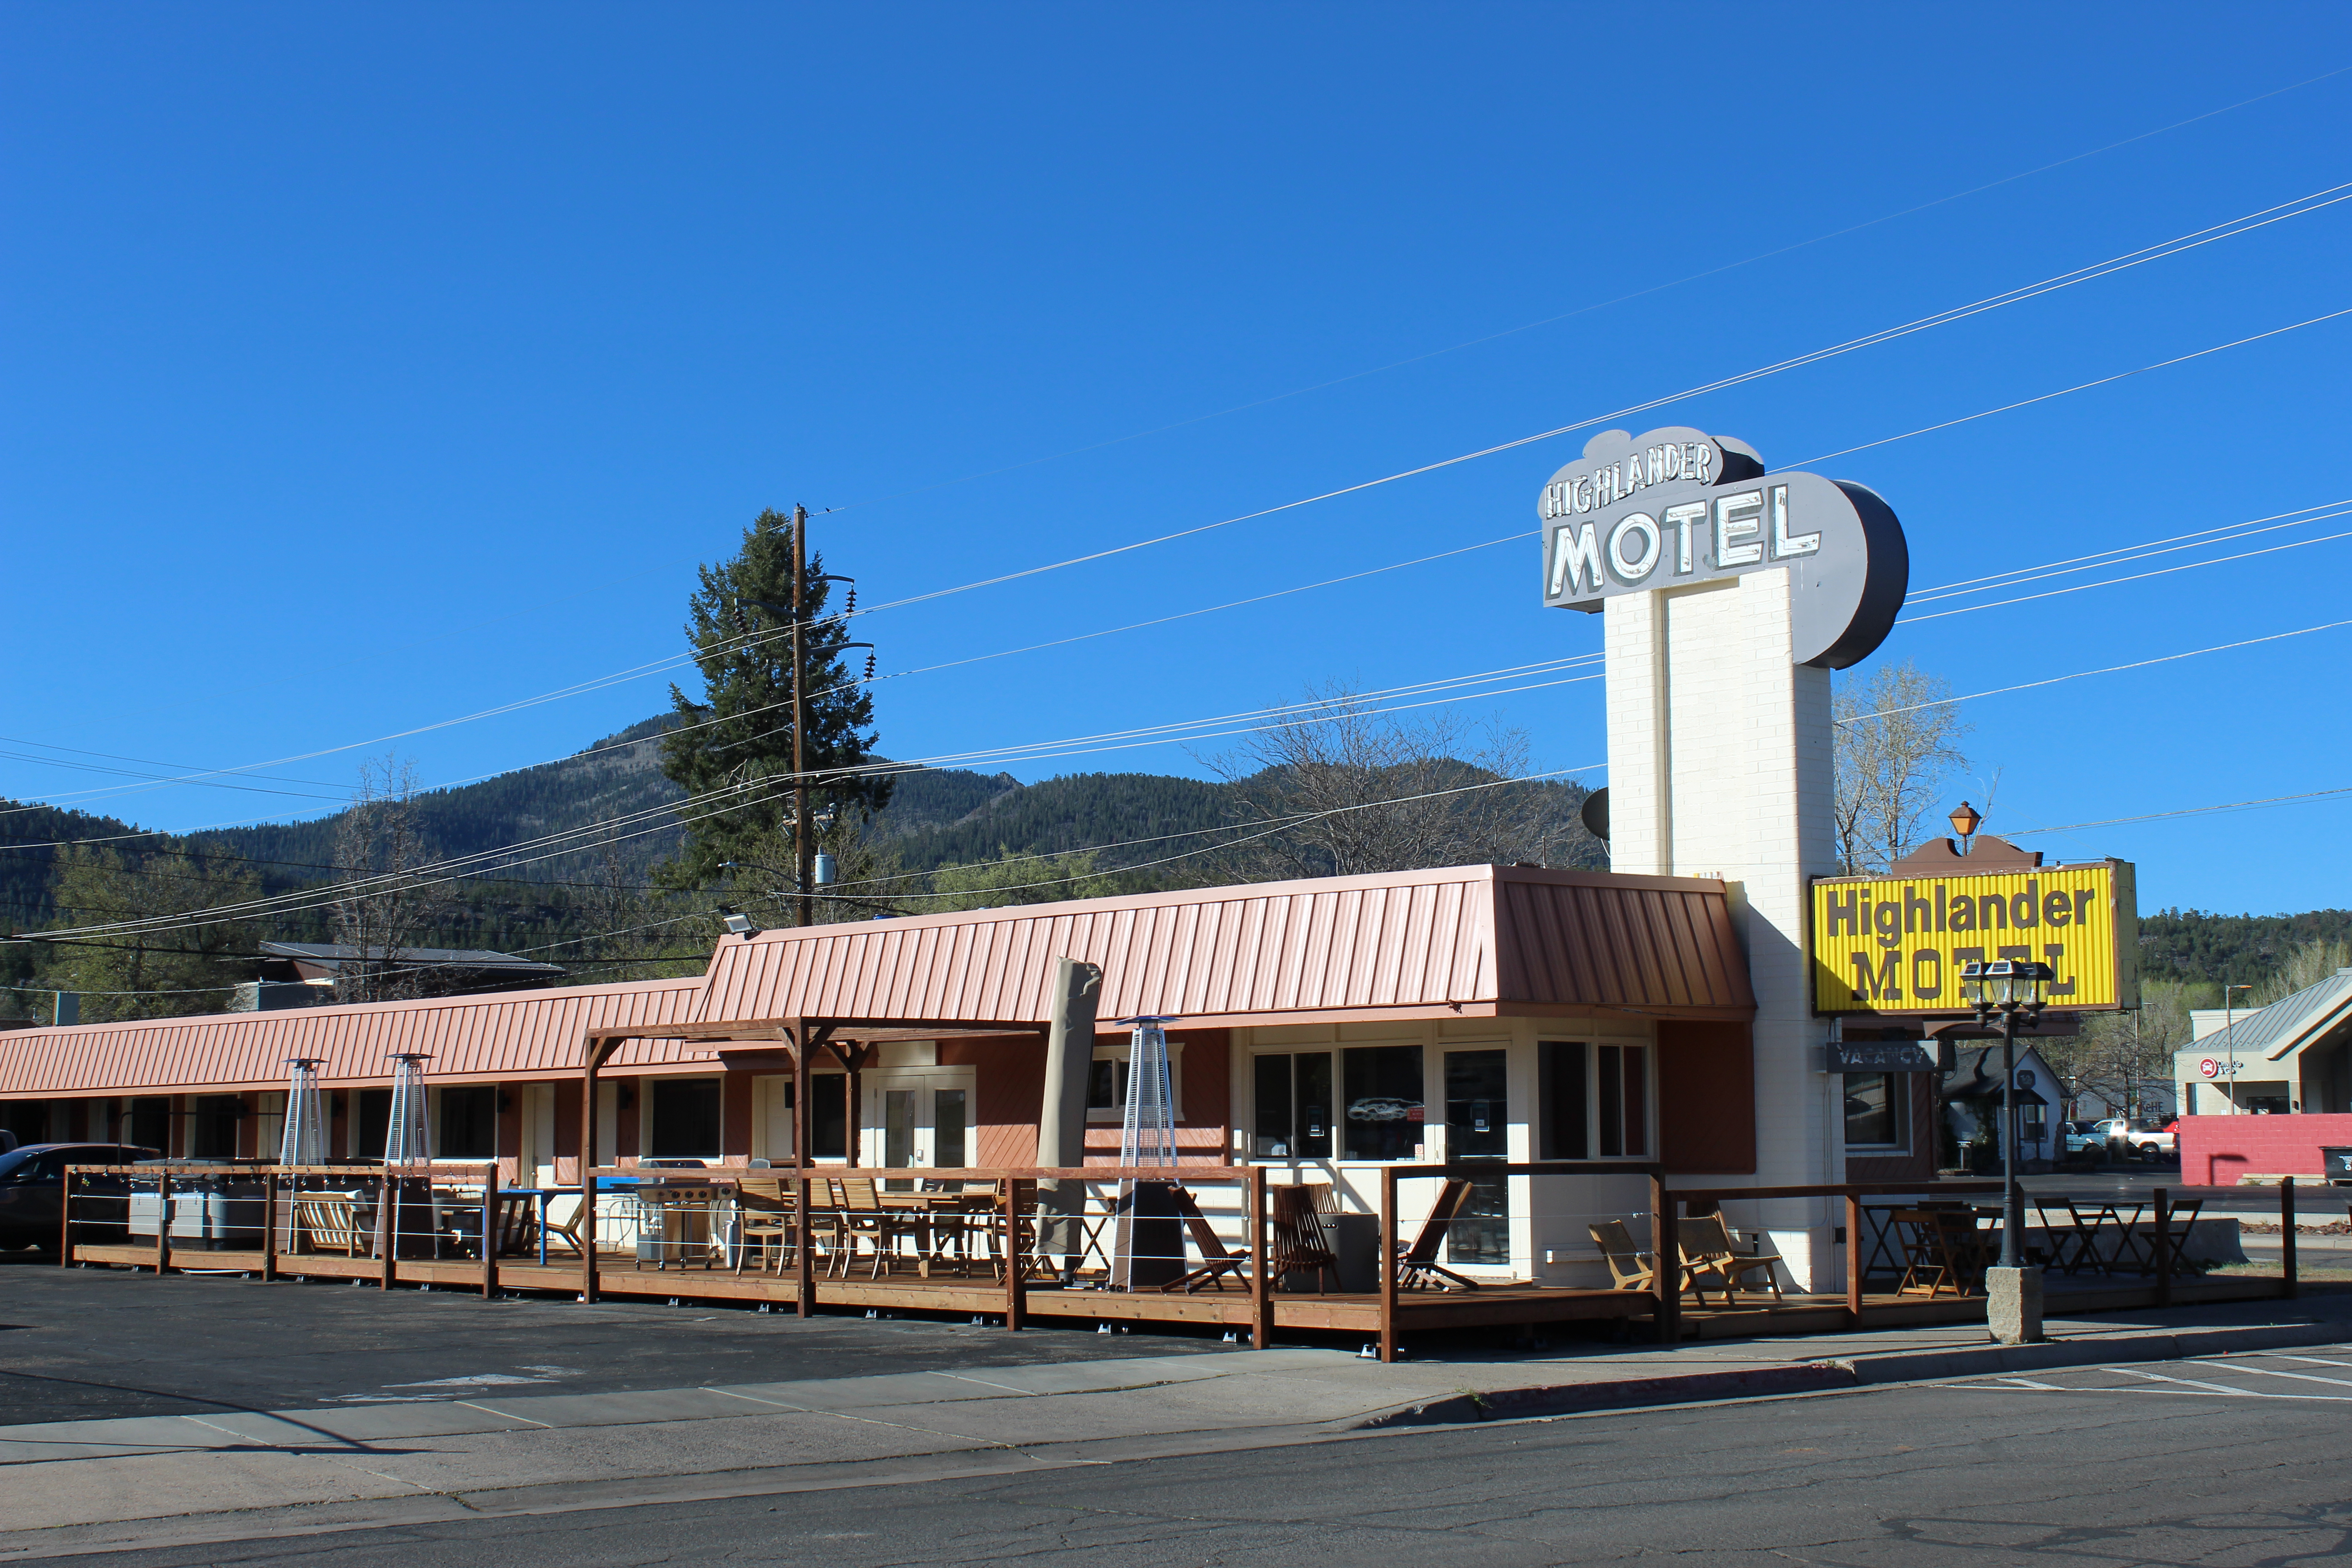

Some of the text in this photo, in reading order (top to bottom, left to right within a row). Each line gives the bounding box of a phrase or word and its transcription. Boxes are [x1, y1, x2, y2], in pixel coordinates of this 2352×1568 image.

[1544, 441, 1712, 519] HIGHLANDER
[1550, 484, 1821, 596] MOTEL
[1827, 879, 2095, 948] Highlander
[1839, 1047, 1924, 1064] VACANCY
